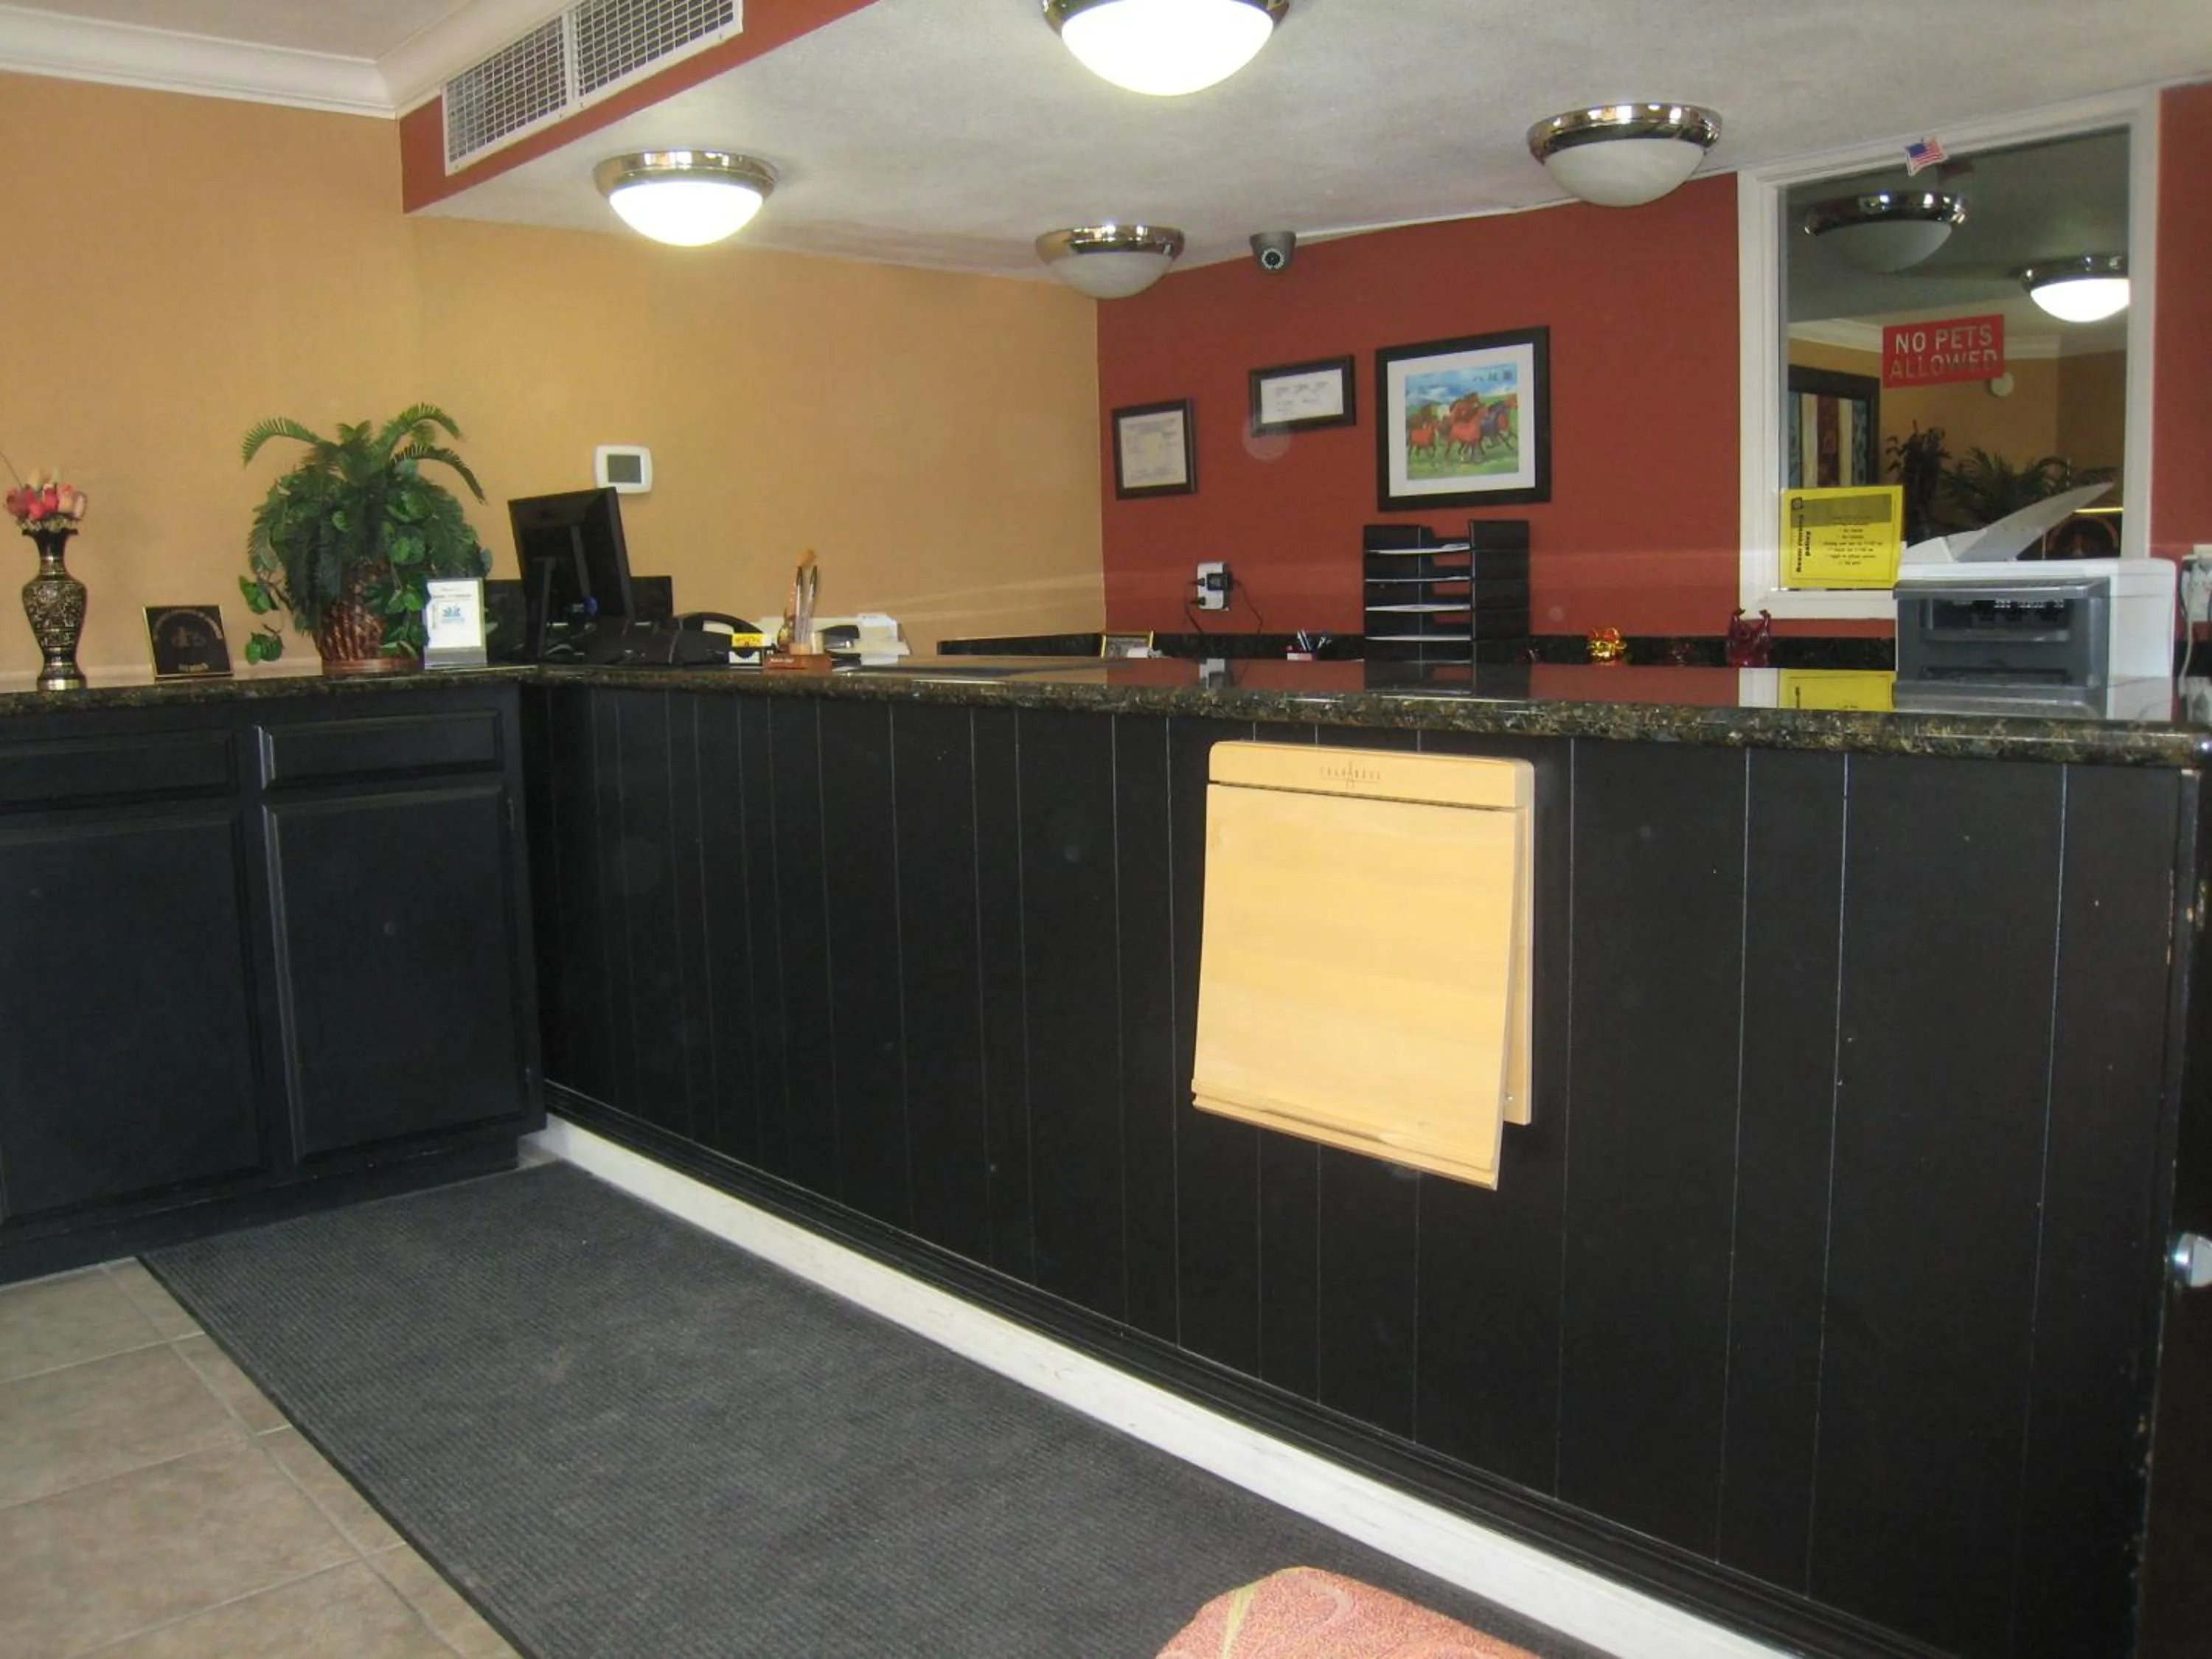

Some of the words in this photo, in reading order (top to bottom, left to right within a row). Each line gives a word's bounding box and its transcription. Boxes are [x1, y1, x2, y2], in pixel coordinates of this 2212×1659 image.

[1895, 330, 1926, 355] NO
[1935, 324, 1993, 351] PETS
[1889, 348, 1997, 380] ALLOWED
